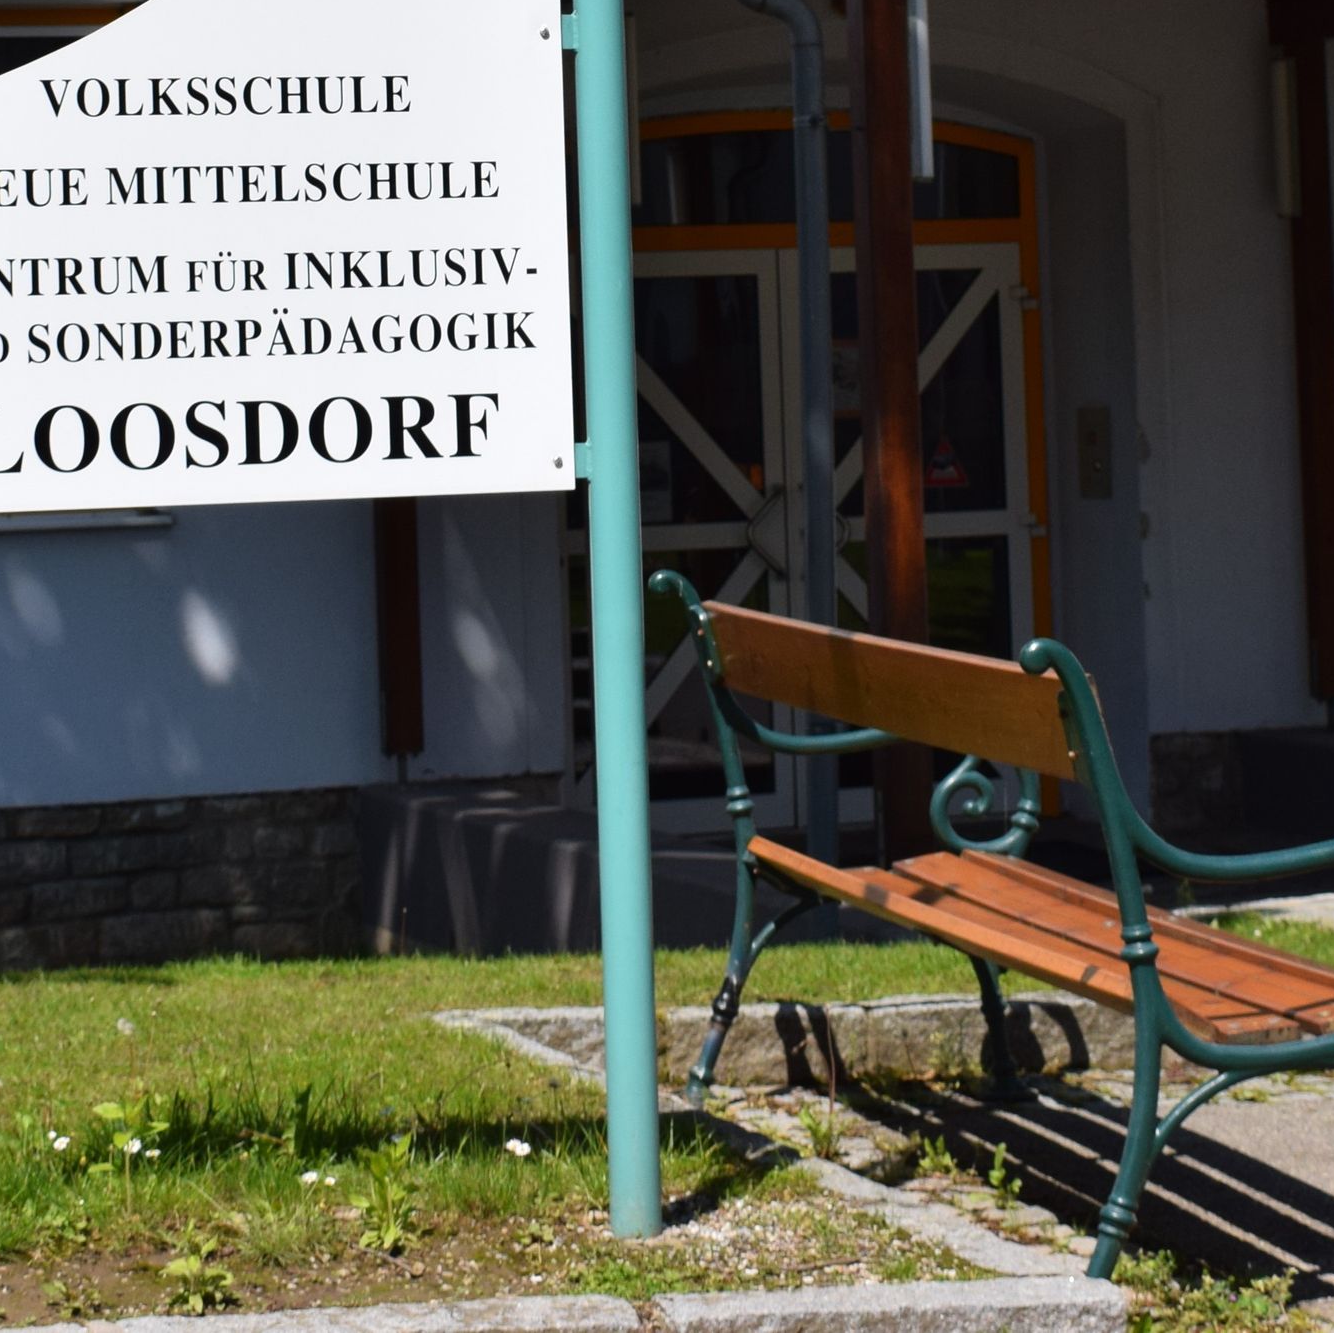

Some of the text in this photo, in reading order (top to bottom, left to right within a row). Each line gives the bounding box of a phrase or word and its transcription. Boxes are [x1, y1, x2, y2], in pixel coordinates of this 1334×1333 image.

[40, 75, 411, 118] VOLKSSCHULE
[105, 161, 500, 205] MITTELSCHULE
[186, 251, 268, 293] FÜR
[284, 247, 538, 290] INKLUSIV-
[27, 307, 537, 364] SONDERPÄDAGOGIK
